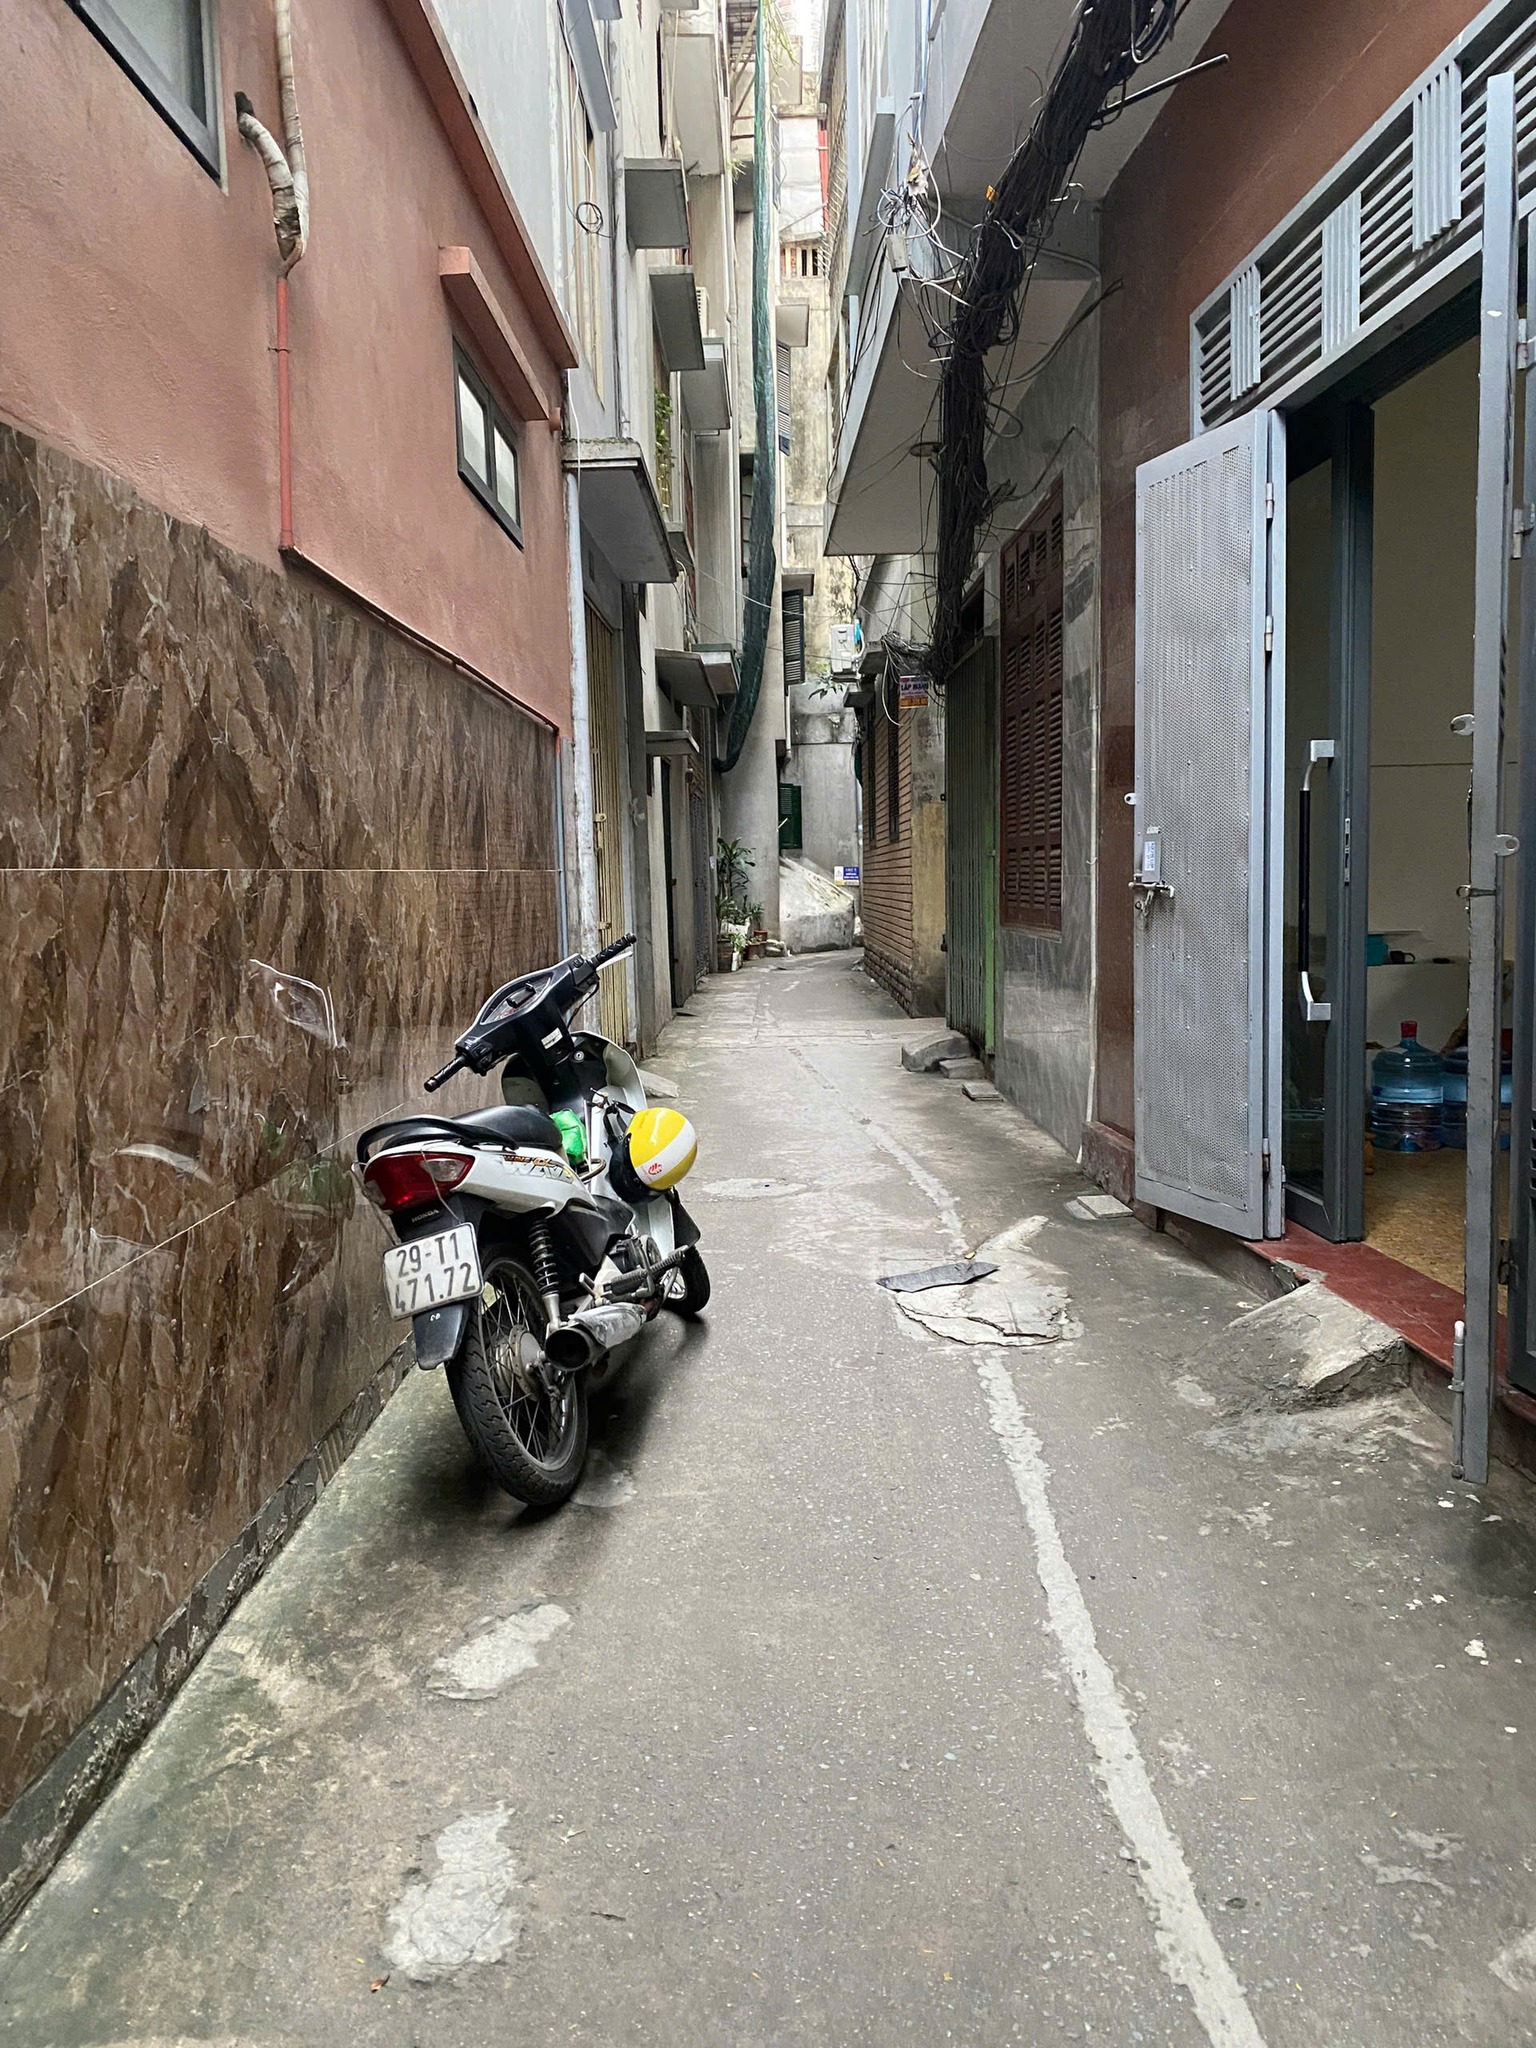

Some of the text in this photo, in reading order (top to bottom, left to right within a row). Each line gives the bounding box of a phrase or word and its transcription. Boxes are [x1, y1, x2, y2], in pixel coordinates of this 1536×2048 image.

[411, 1209, 440, 1223] HONDA
[396, 1231, 460, 1278] 29-T1
[395, 1262, 476, 1313] 471.72
